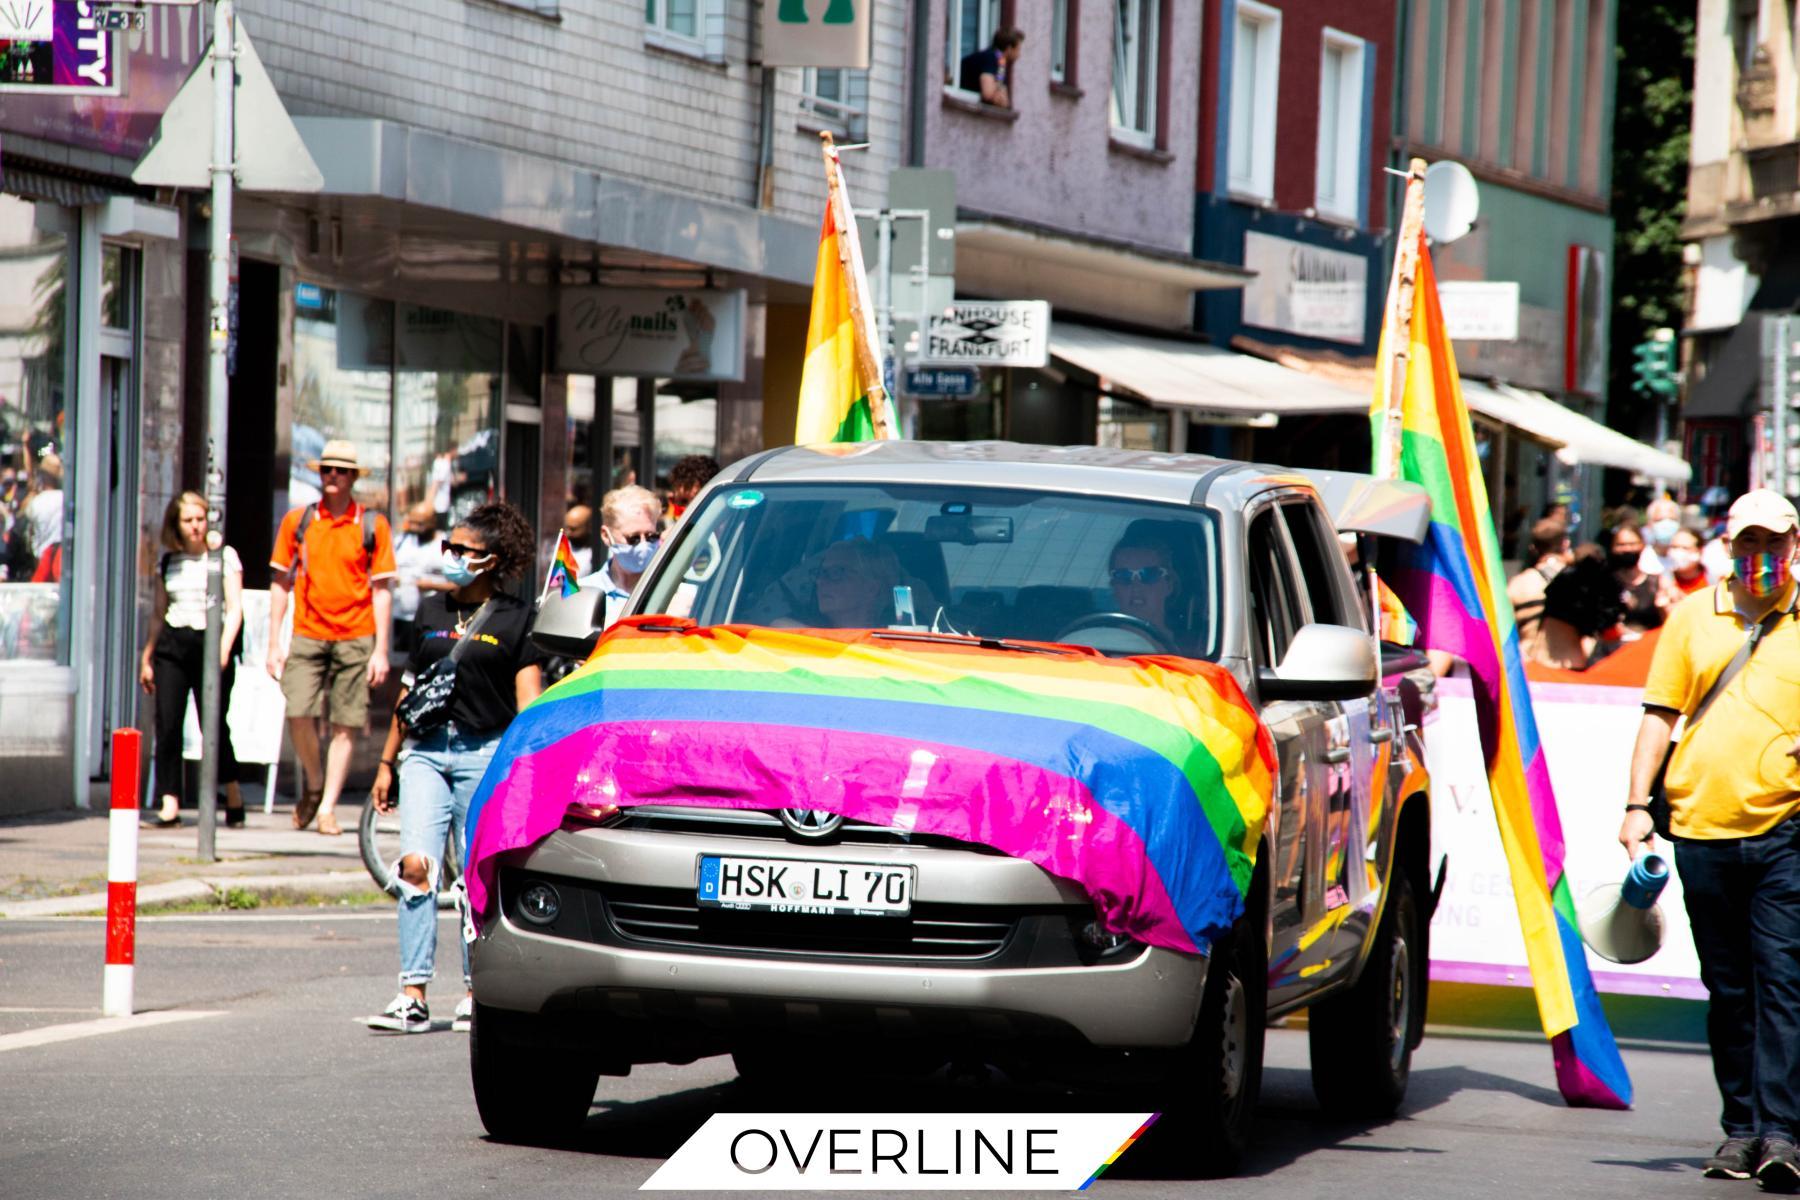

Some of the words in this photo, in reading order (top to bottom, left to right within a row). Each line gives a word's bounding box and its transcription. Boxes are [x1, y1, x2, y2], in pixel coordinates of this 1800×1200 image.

[568, 296, 629, 366] My
[630, 311, 677, 331] nails
[929, 335, 1031, 358] FRANKFURT
[705, 882, 713, 893] D
[721, 863, 788, 899] HSK
[813, 867, 850, 901] LI
[864, 871, 905, 904] 70
[770, 904, 835, 915] HOFFMANN
